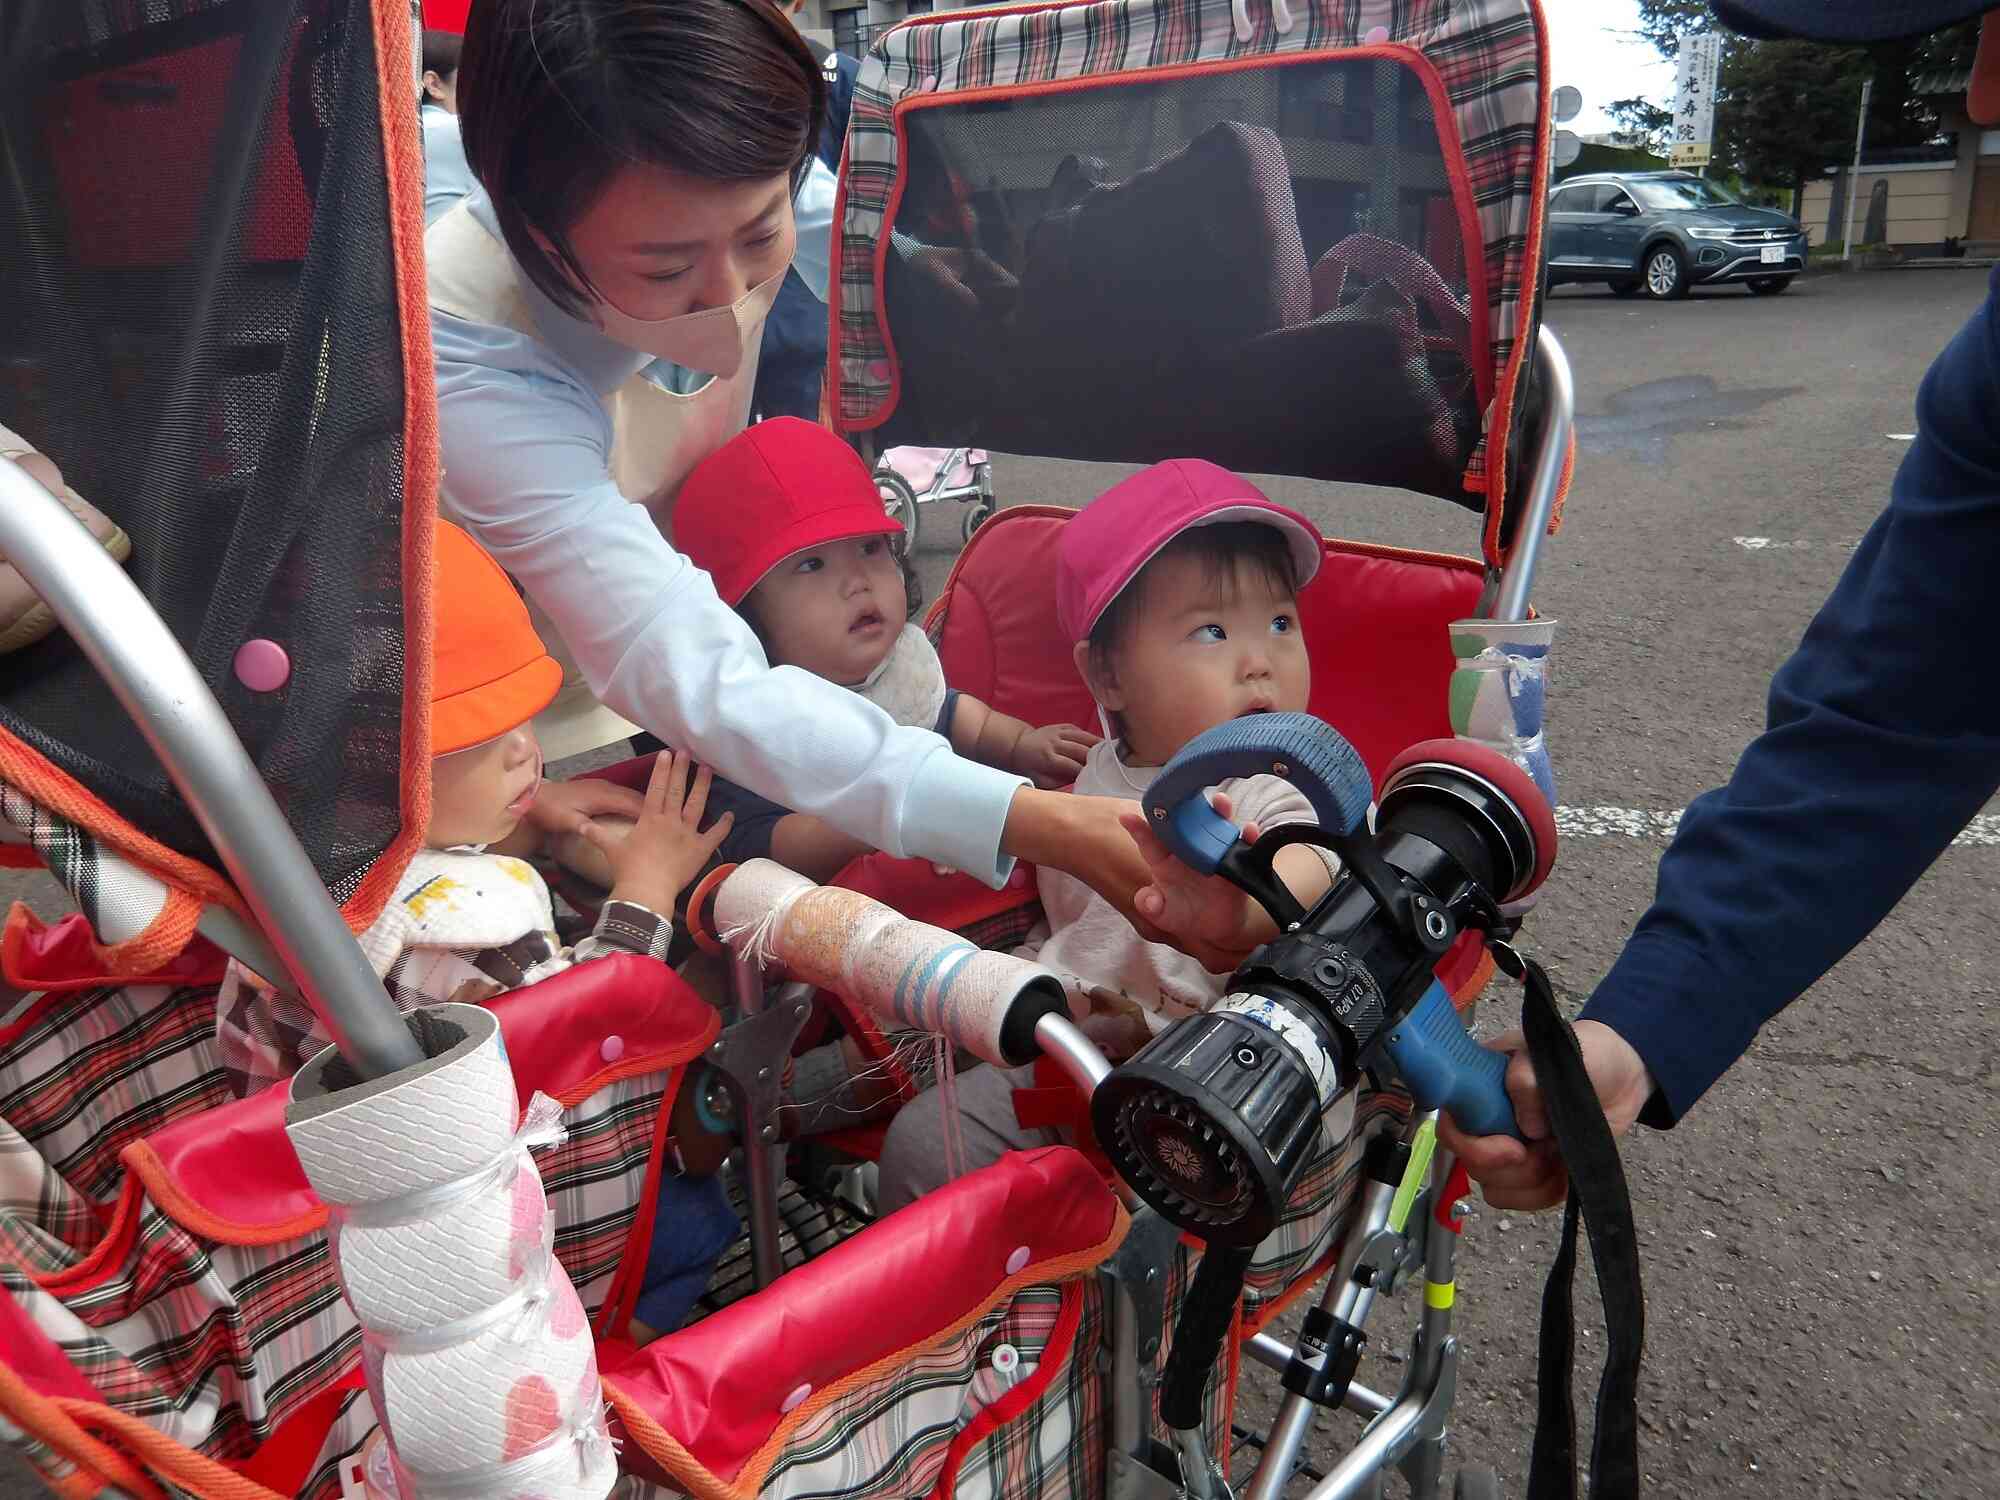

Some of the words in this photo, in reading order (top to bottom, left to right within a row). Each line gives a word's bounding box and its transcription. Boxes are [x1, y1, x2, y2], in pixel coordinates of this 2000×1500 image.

[1677, 76, 1700, 141] 光寿院
[1351, 983, 1364, 1001] 0.7
[1335, 995, 1356, 1016] MPa
